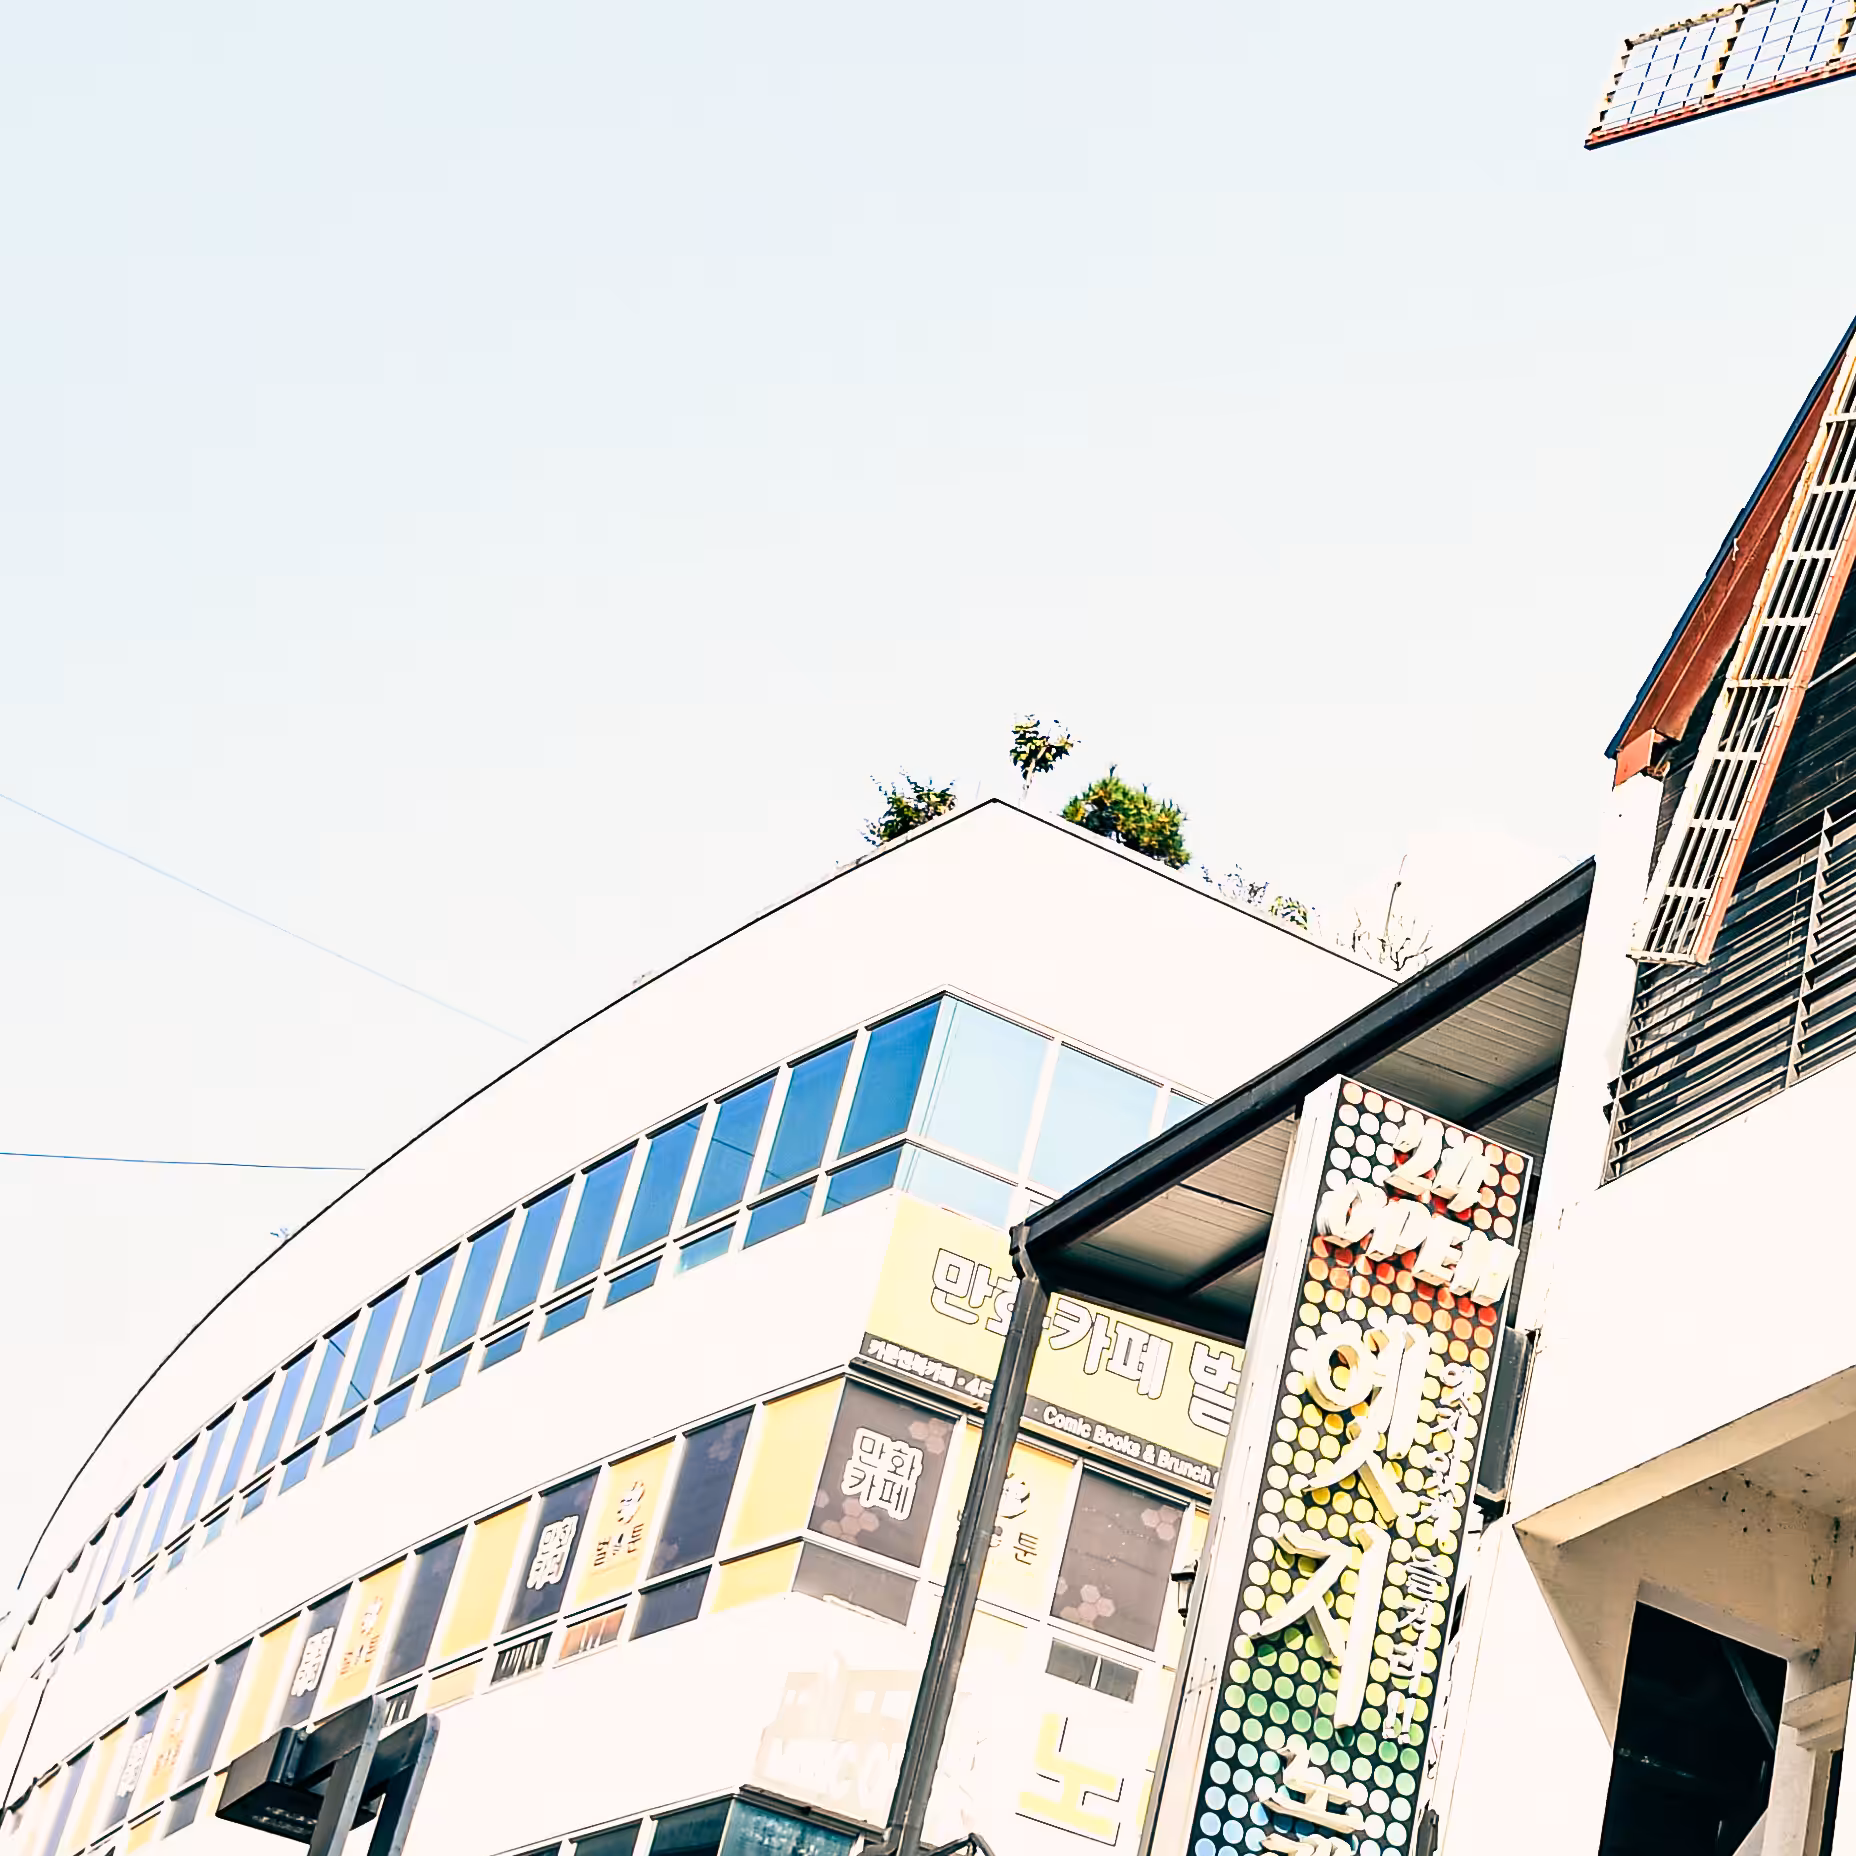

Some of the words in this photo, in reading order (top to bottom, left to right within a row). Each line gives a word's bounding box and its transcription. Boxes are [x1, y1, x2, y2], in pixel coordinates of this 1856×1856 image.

[1316, 1178, 1520, 1306] OPEN
[855, 1430, 922, 1482] 만화
[1043, 1406, 1092, 1439] Comic
[1092, 1425, 1140, 1459] Books
[1142, 1441, 1156, 1463] &
[1157, 1450, 1213, 1485] Brunch
[845, 1465, 913, 1517] 카페
[1252, 1322, 1430, 1728] 엣지
